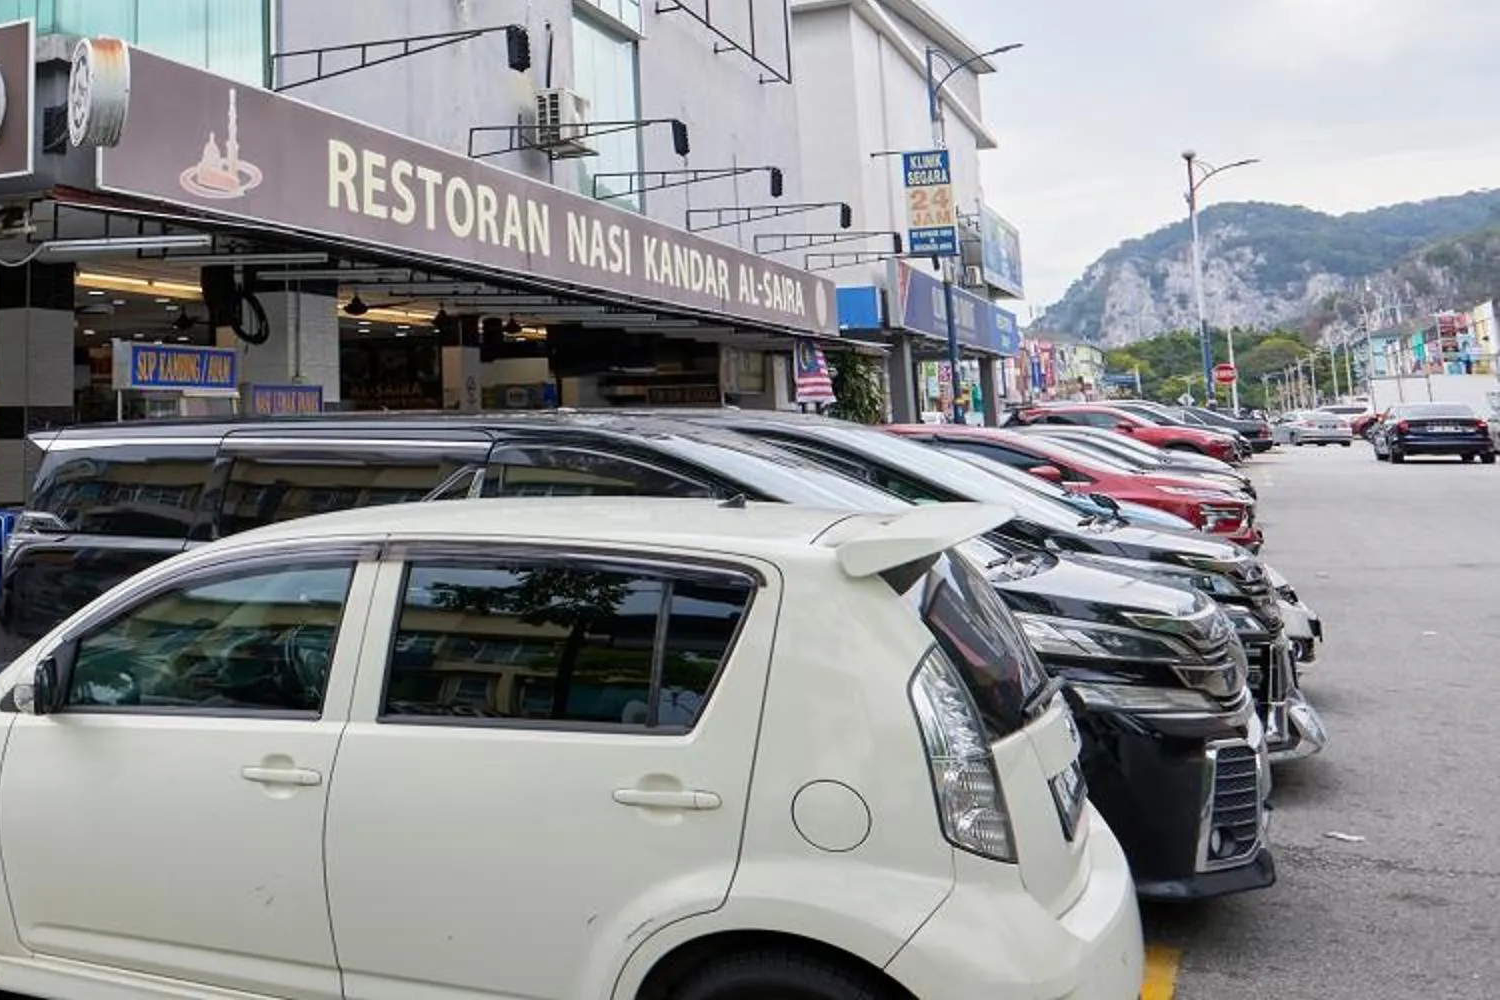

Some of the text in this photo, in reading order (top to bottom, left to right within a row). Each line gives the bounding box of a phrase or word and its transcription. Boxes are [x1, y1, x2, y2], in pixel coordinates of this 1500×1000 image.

[909, 153, 943, 169] KLINIK
[907, 170, 949, 186] SEGARA
[910, 188, 950, 211] 24
[913, 210, 952, 227] JAM
[328, 138, 806, 317] RESTORAN NASI KANDAR AL-SAIRA
